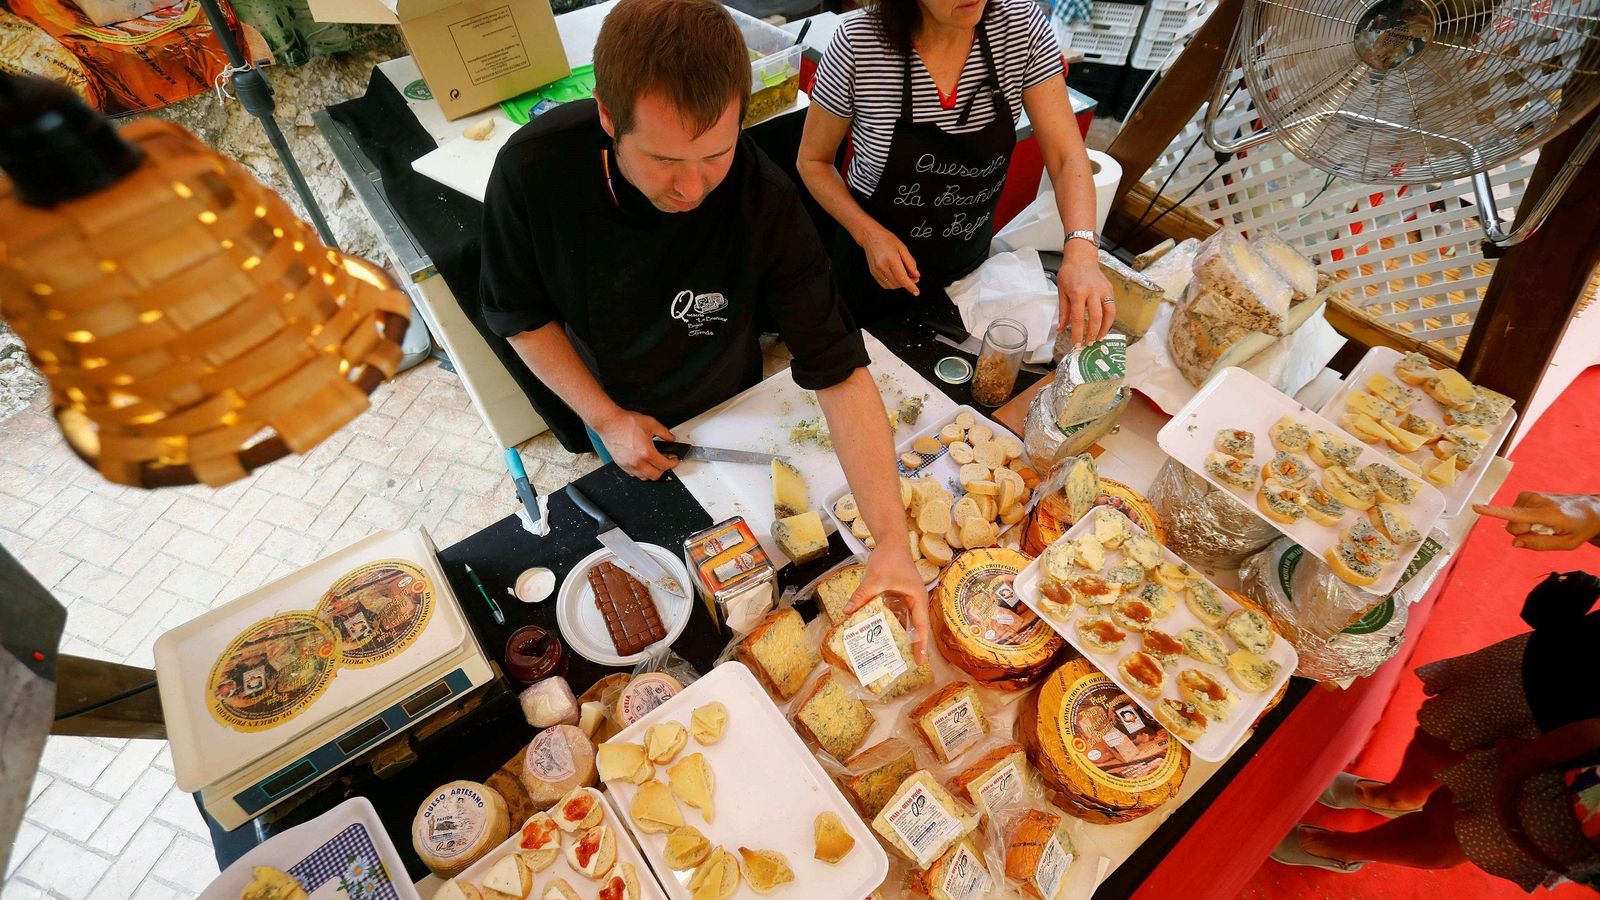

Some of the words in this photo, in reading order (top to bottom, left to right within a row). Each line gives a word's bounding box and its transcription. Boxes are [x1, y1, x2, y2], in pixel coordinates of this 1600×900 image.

[894, 183, 925, 207] La
[910, 220, 933, 238] de
[966, 565, 986, 577] ORIGEN
[986, 564, 1020, 573] PROTEGIDA
[406, 592, 431, 641] DENOMINACIÓN
[398, 641, 406, 650] DE
[341, 657, 364, 665] PROTE
[366, 650, 395, 664] ORIGEN
[282, 710, 292, 719] DE
[1064, 686, 1080, 736] DENOMINACIÓN
[246, 716, 280, 727] ORIGEN
[424, 793, 446, 818] QUESO
[450, 788, 484, 808] ARTESANO
